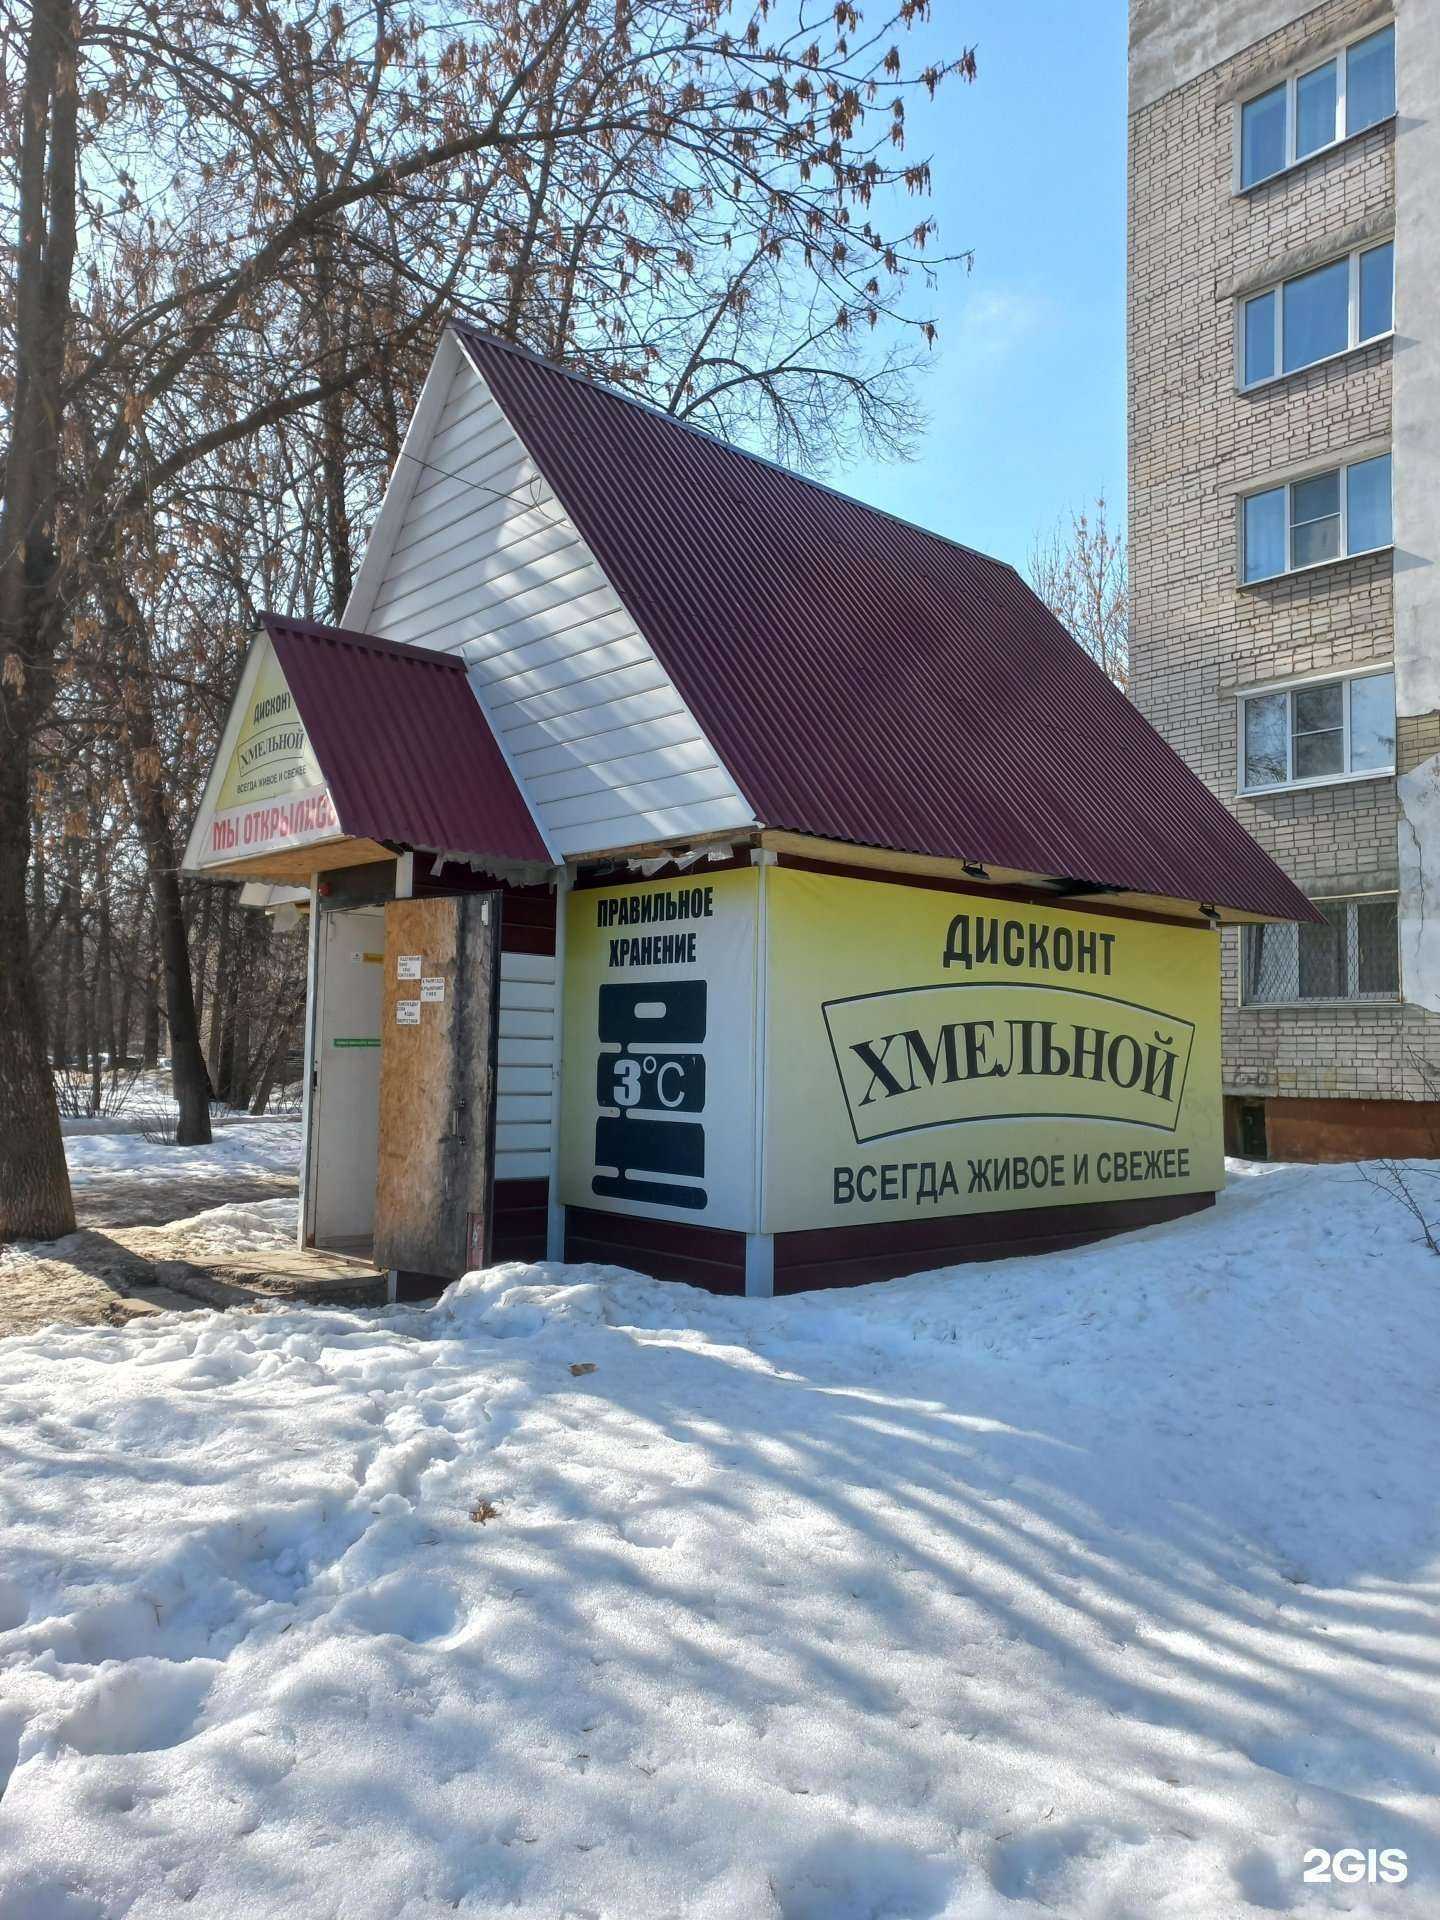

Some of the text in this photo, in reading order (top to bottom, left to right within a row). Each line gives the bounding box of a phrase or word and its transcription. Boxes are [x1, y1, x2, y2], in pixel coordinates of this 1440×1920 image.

[253, 691, 291, 726] ДИСКОНТ
[239, 728, 304, 768] ХМЕЛЬНОЙ
[237, 765, 307, 794] ВСЕГДА ЖИВОЕ И СВЕЖЕЕ
[213, 794, 337, 851] МЫ ОТКРЫЛИСЬ
[597, 887, 713, 928] ПРАВИЛЬНОЕ
[608, 933, 697, 968] ХРАНЕНИЕ
[942, 914, 1116, 975] ДИСКОНТ
[849, 1020, 1180, 1107] ХМЕЛЬНОЙ
[833, 1148, 1190, 1205] ВСЕГДА ЖИВОЕ И СВЕЖЕЕ
